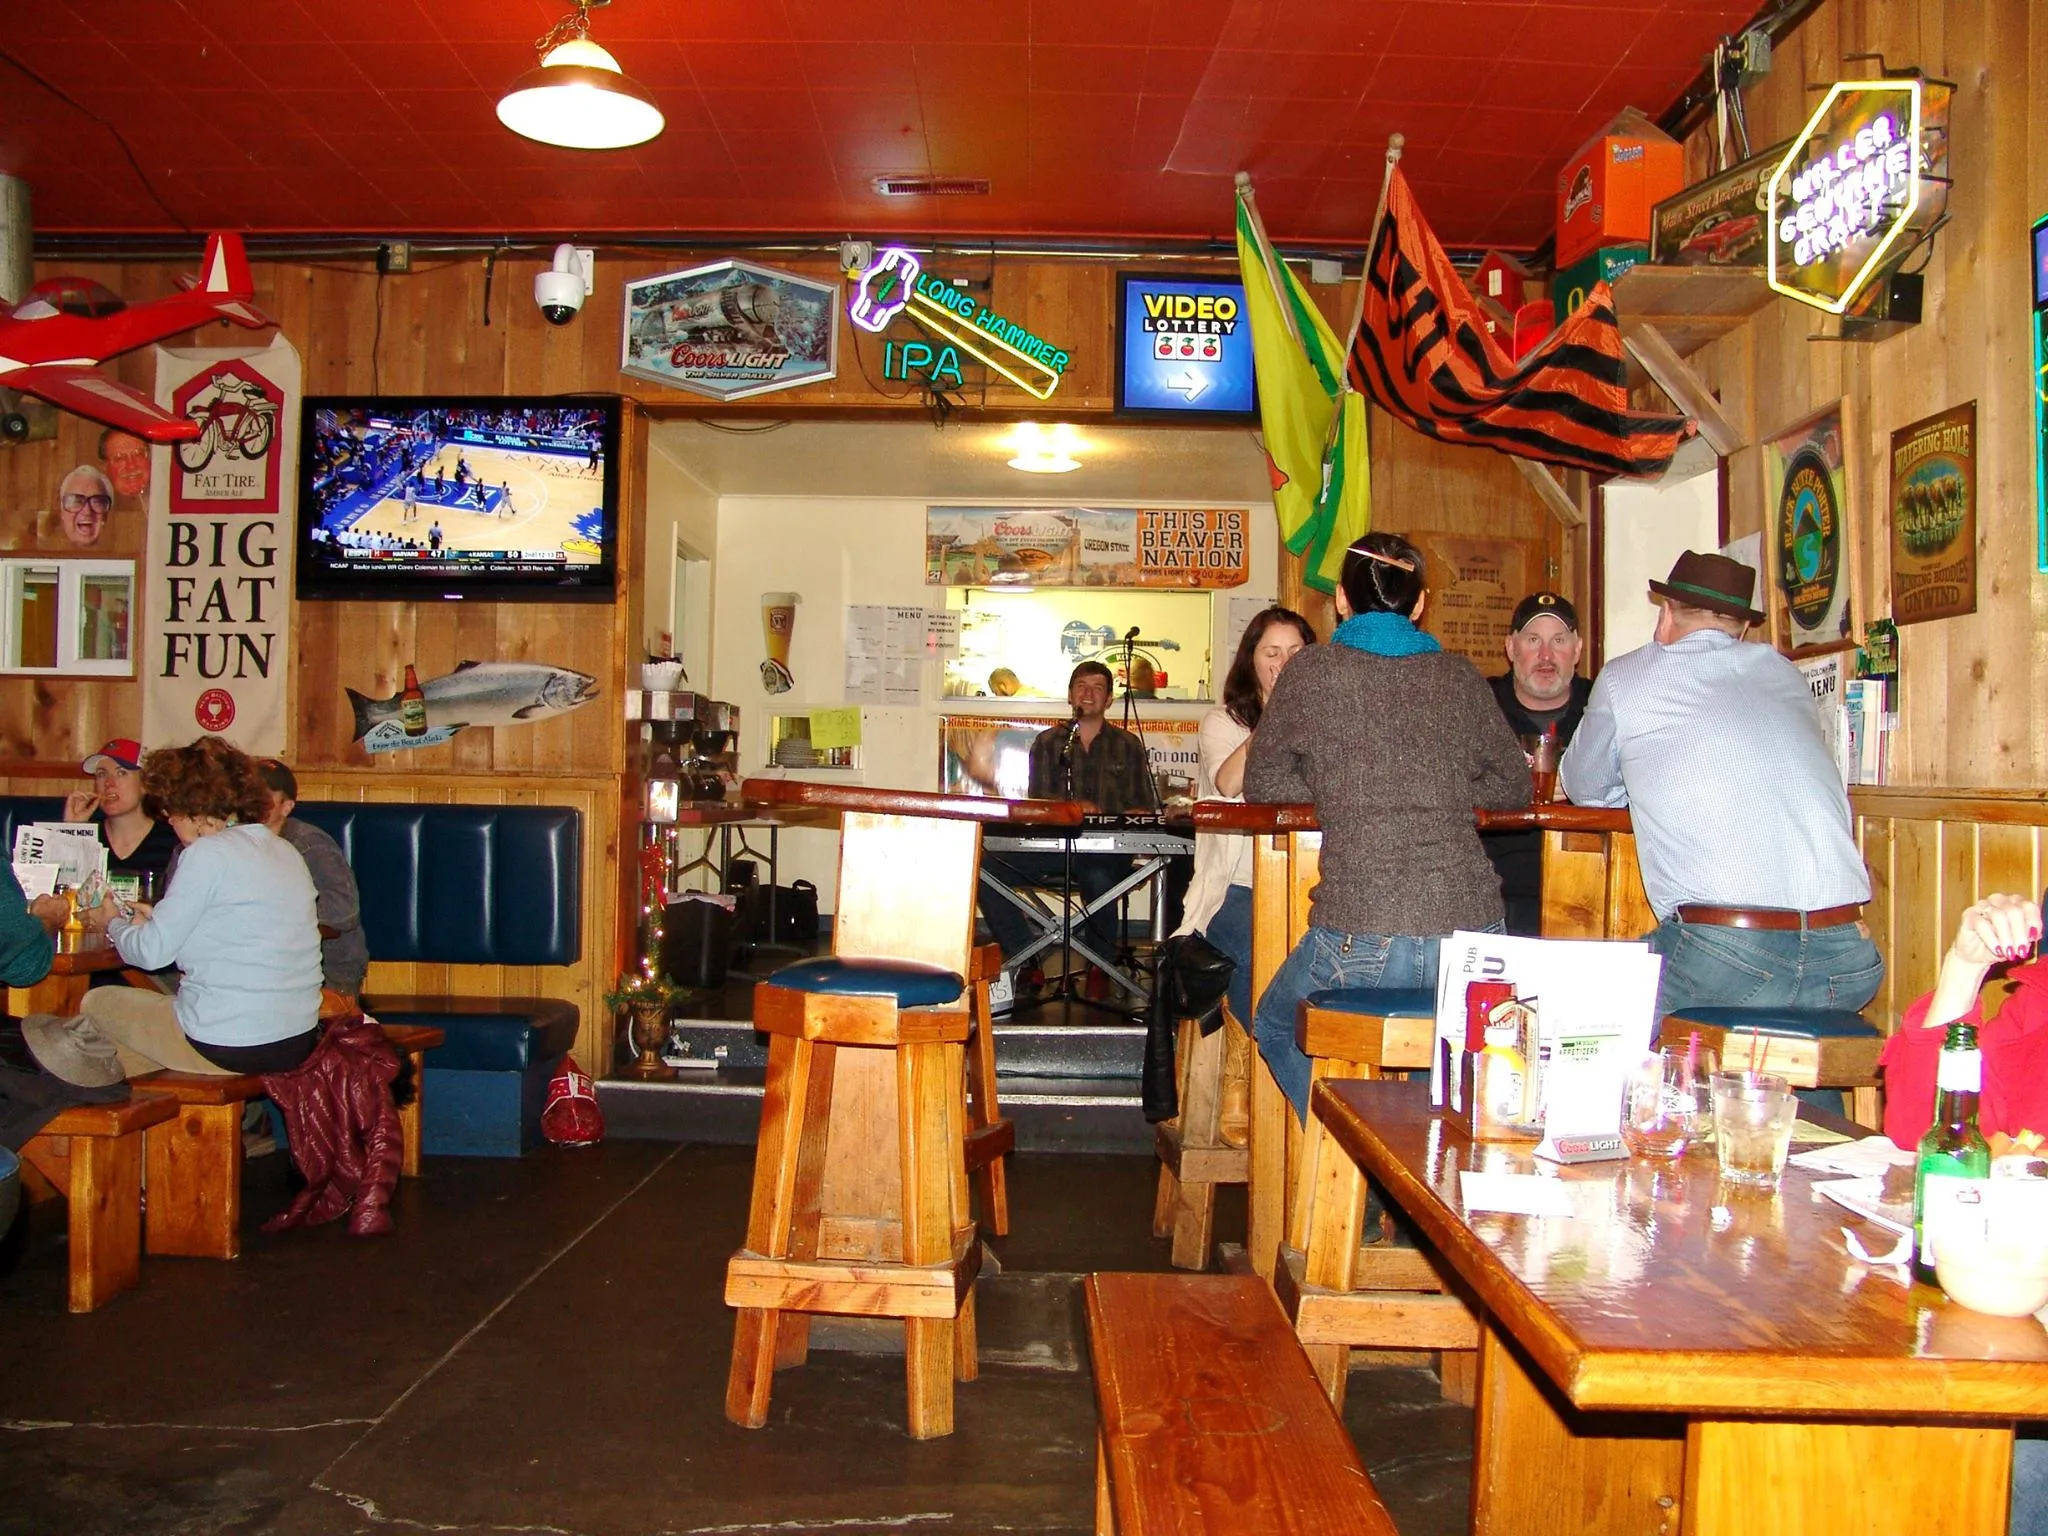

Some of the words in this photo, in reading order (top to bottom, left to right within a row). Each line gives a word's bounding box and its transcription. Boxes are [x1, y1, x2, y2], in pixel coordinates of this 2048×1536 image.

[1143, 294, 1238, 321] VIDEO
[916, 273, 976, 317] LONG
[976, 308, 1069, 374] HAMMER
[1144, 318, 1235, 334] LOTTERY
[671, 342, 727, 368] Coors
[726, 352, 791, 370] LIGHT
[884, 342, 963, 385] IPA
[685, 370, 704, 379] THE
[705, 371, 738, 380] SILVER
[739, 372, 776, 381] BULLET
[1895, 432, 1940, 478] WATERING
[1943, 424, 1970, 457] HOLE
[194, 474, 220, 488] FAT
[222, 474, 255, 488] TIRE
[1784, 496, 1796, 549] BLACK
[1791, 467, 1816, 493] BUTTE
[1814, 476, 1832, 538] PORTER
[994, 521, 1032, 537] Coors
[1145, 511, 1206, 530] THIS
[1217, 512, 1241, 530] IS
[165, 521, 278, 567] BIG
[1084, 538, 1110, 552] OREGON
[1110, 543, 1130, 552] STATE
[1141, 530, 1244, 549] BEAVER
[430, 550, 442, 558] 47
[1143, 549, 1242, 568] NATION
[165, 576, 276, 622] FAT
[1904, 587, 1960, 614] UNWIND
[897, 611, 922, 619] MENU
[160, 632, 276, 679] FUN
[1129, 721, 1176, 732] SATURDAY
[1146, 747, 1199, 764] Corona
[21, 832, 30, 846] PUB
[77, 829, 93, 837] MENU
[1463, 946, 1478, 973] PUB
[1590, 1140, 1621, 1151] LIGHT
